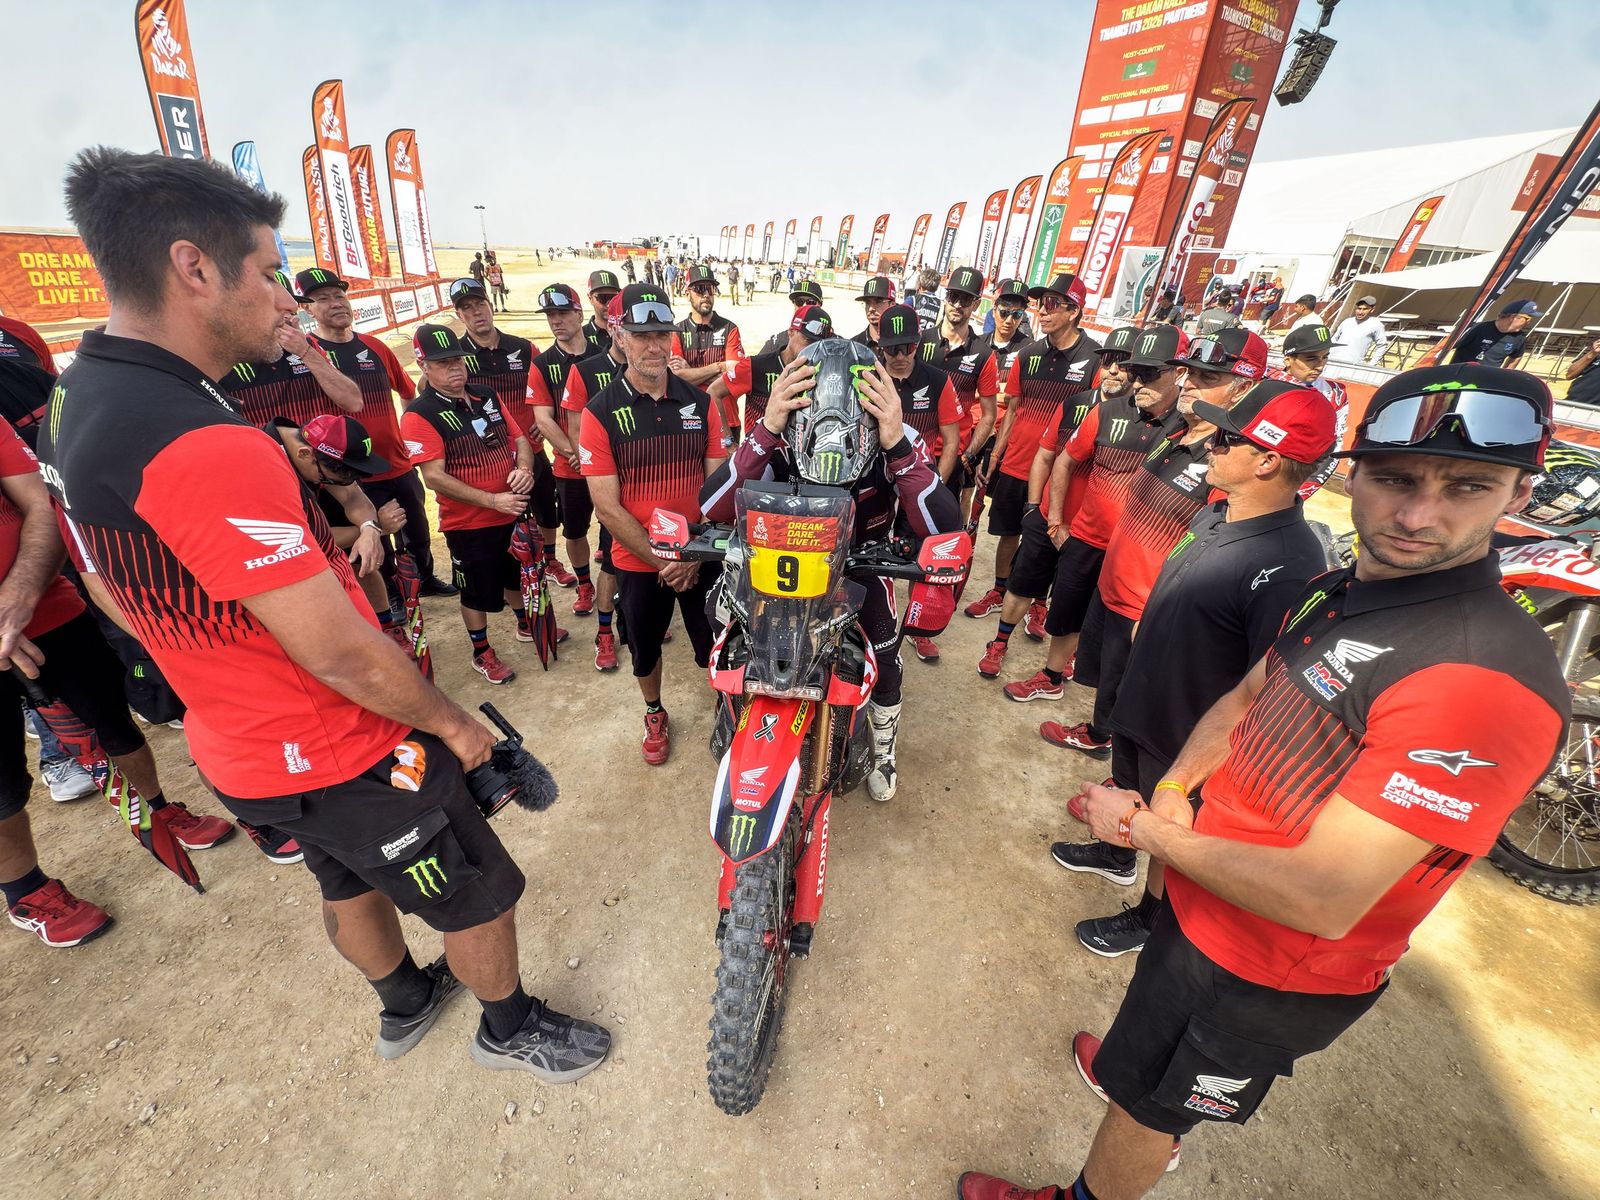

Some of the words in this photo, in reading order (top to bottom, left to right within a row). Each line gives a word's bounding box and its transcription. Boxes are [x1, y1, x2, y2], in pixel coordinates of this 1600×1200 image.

[151, 52, 190, 79] DAKAR
[331, 163, 358, 267] BFGoodrich
[1083, 215, 1121, 291] MOTUL
[28, 271, 89, 287] DARE.
[37, 288, 80, 304] LIVE
[83, 287, 105, 302] IT.
[1259, 426, 1283, 442] HRC
[653, 529, 676, 537] HONDA
[787, 530, 816, 539] DARE.
[788, 521, 825, 531] DREAM.
[786, 538, 808, 546] LIVE
[243, 544, 311, 570] HONDA
[777, 555, 799, 592] 9
[929, 574, 963, 583] MOTUL
[1323, 650, 1354, 683] HONDA
[284, 743, 297, 774] Diverse
[739, 779, 765, 787] HONDA
[1386, 771, 1473, 814] Diverse
[735, 798, 761, 808] MOTUL
[1384, 785, 1470, 822] ExtremeTeam
[381, 829, 417, 855] Diverse
[816, 806, 831, 897] HONDA
[1192, 1084, 1240, 1108] HONDA
